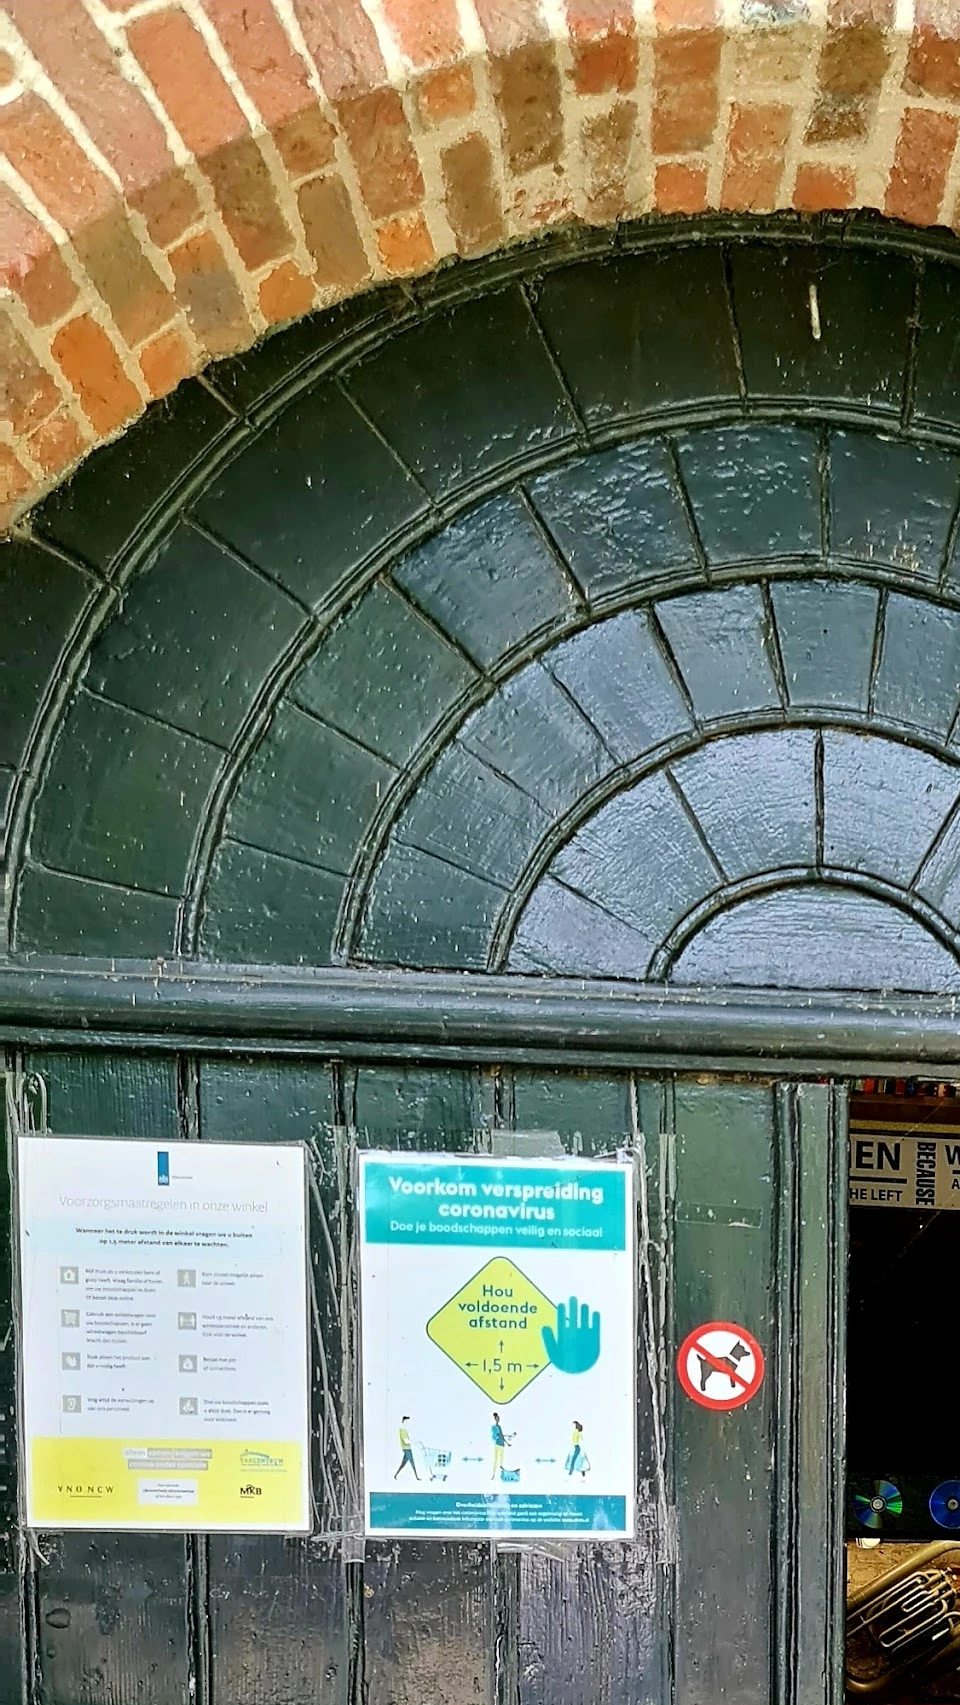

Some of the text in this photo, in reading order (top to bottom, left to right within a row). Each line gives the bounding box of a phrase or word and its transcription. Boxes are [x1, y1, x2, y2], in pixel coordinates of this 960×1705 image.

[849, 1141, 900, 1170] EN
[916, 1142, 936, 1206] BECAUSE
[389, 1176, 603, 1204] Voorkom verspreiding
[849, 1188, 903, 1202] HE LEFT
[59, 1196, 268, 1212] Voorzorgsmaatregelen in onze winkel
[439, 1202, 555, 1220] coronavirus
[391, 1221, 603, 1238] Doe je boodschappen veilig en sociaal
[483, 1285, 513, 1297] Hou
[458, 1301, 537, 1314] voldoende
[469, 1316, 527, 1329] afstand
[483, 1359, 522, 1374] 1,5 m
